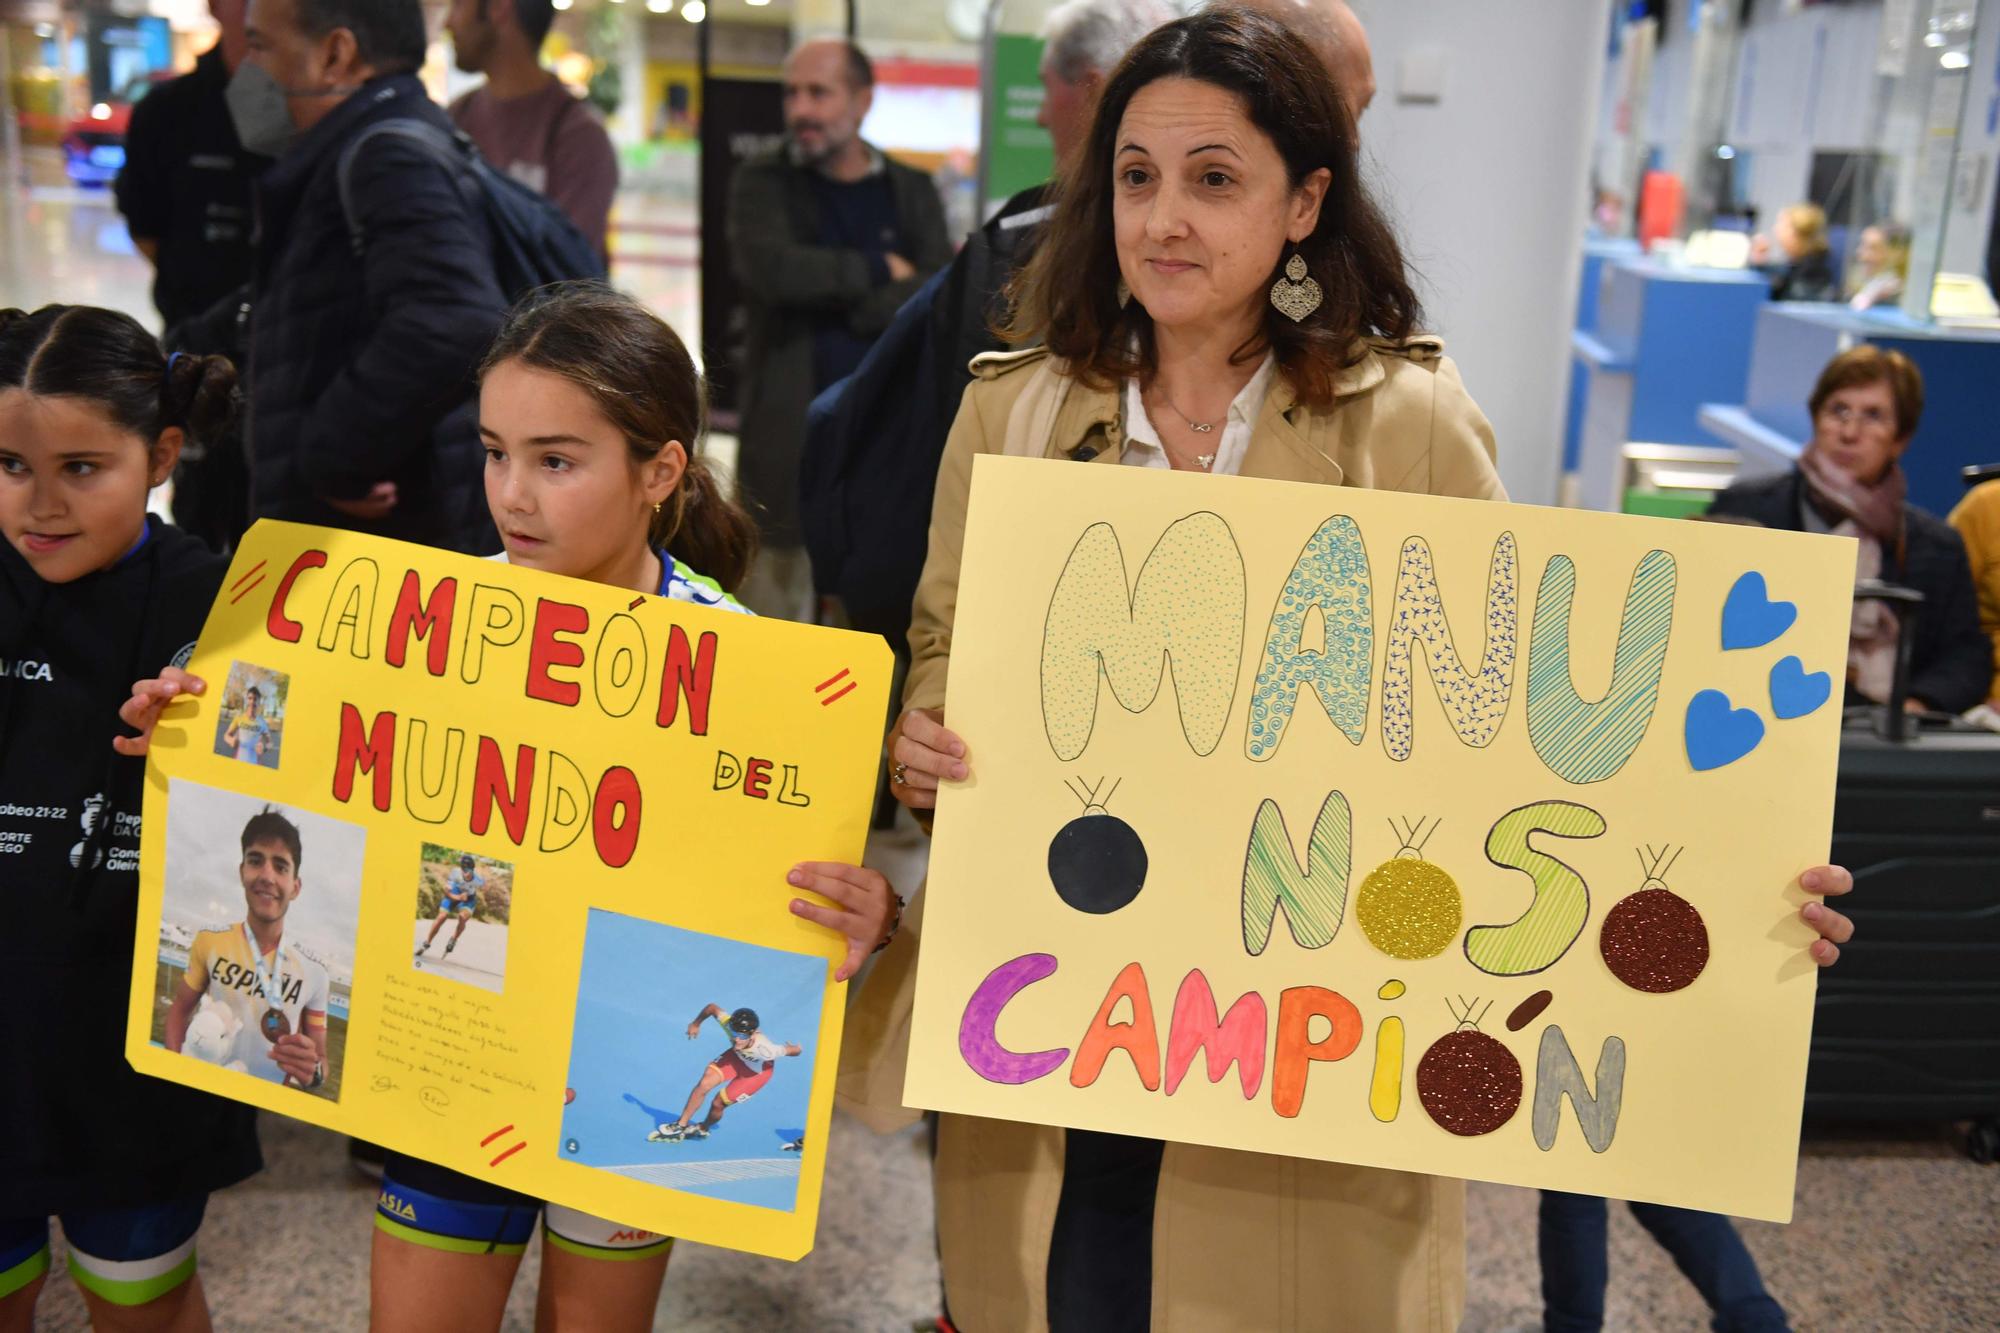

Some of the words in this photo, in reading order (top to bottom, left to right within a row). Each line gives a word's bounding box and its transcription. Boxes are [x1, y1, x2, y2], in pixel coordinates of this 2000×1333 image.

[266, 549, 718, 736] CAMPEÓN
[1041, 511, 1677, 784] MANU
[35, 806, 68, 819] 21-22
[332, 702, 642, 868] MUNDO
[713, 750, 810, 807] DEL
